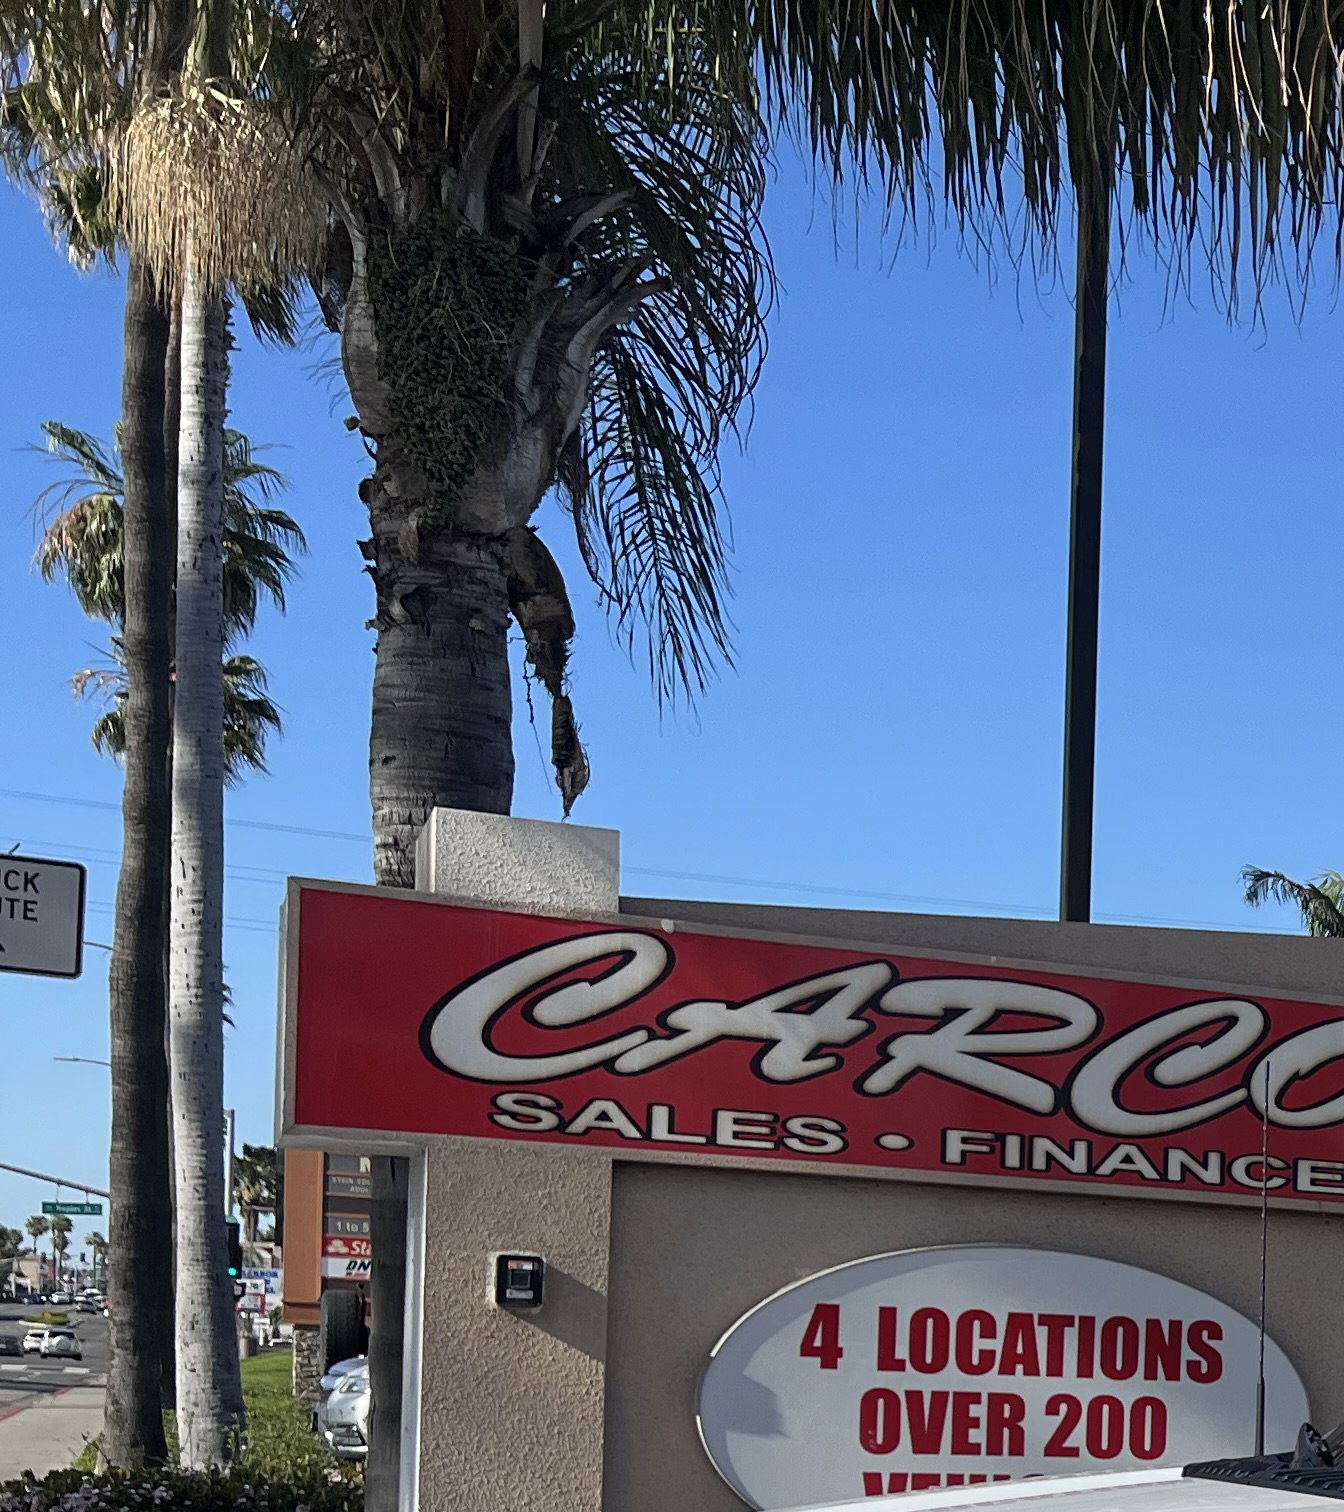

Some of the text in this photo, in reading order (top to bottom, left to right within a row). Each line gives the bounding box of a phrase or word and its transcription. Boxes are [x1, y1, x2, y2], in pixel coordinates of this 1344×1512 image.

[0, 868, 40, 895] CK
[0, 896, 39, 922] TE
[488, 1092, 848, 1155] SALES
[800, 1304, 1224, 1385] 4 LOCATIONS
[858, 1387, 1168, 1461] OVER 200
